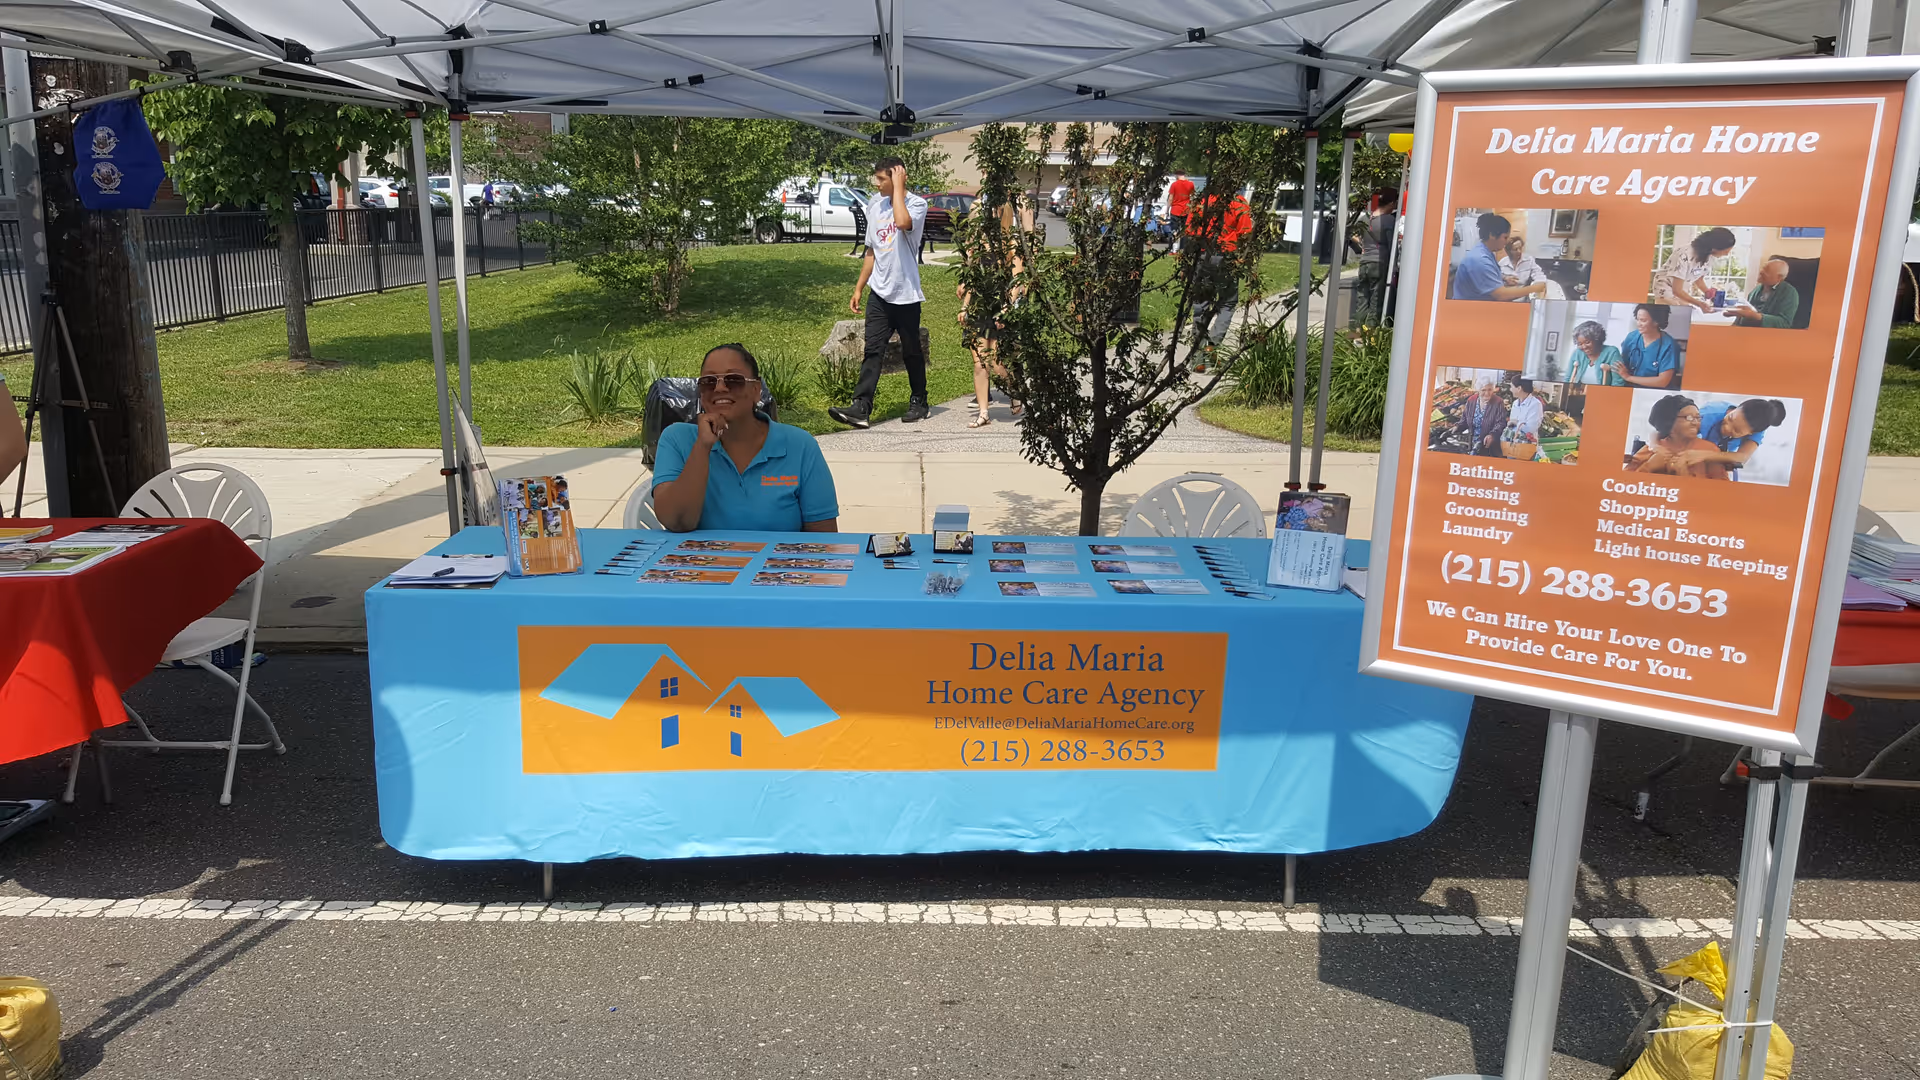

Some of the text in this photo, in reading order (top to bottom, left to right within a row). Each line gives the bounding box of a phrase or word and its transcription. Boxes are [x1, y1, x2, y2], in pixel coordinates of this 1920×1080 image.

[1485, 125, 1820, 156] Delia Maria Home
[1532, 168, 1758, 205] Care Agency
[1448, 463, 1515, 485] Bathing
[1446, 482, 1520, 505] Dressing
[1601, 479, 1679, 503] Cooking
[1444, 502, 1529, 527] Grooming
[1598, 498, 1689, 525] Shopping
[1443, 521, 1513, 544] Laundry
[1597, 519, 1745, 549] Medical Escorts
[1594, 539, 1789, 580] Light house Keeping
[1442, 551, 1729, 617] (215) 288-3653
[1427, 600, 1747, 664] We Can Hire Your Love One To
[969, 642, 1164, 671] Delia Maria
[1466, 629, 1692, 680] Provide Care For You.
[927, 681, 1204, 713] Home Care Agency
[934, 717, 1195, 733] EDelValle@DeliaMariaHomeCare.org
[961, 738, 1165, 766] (215) 288-3653
